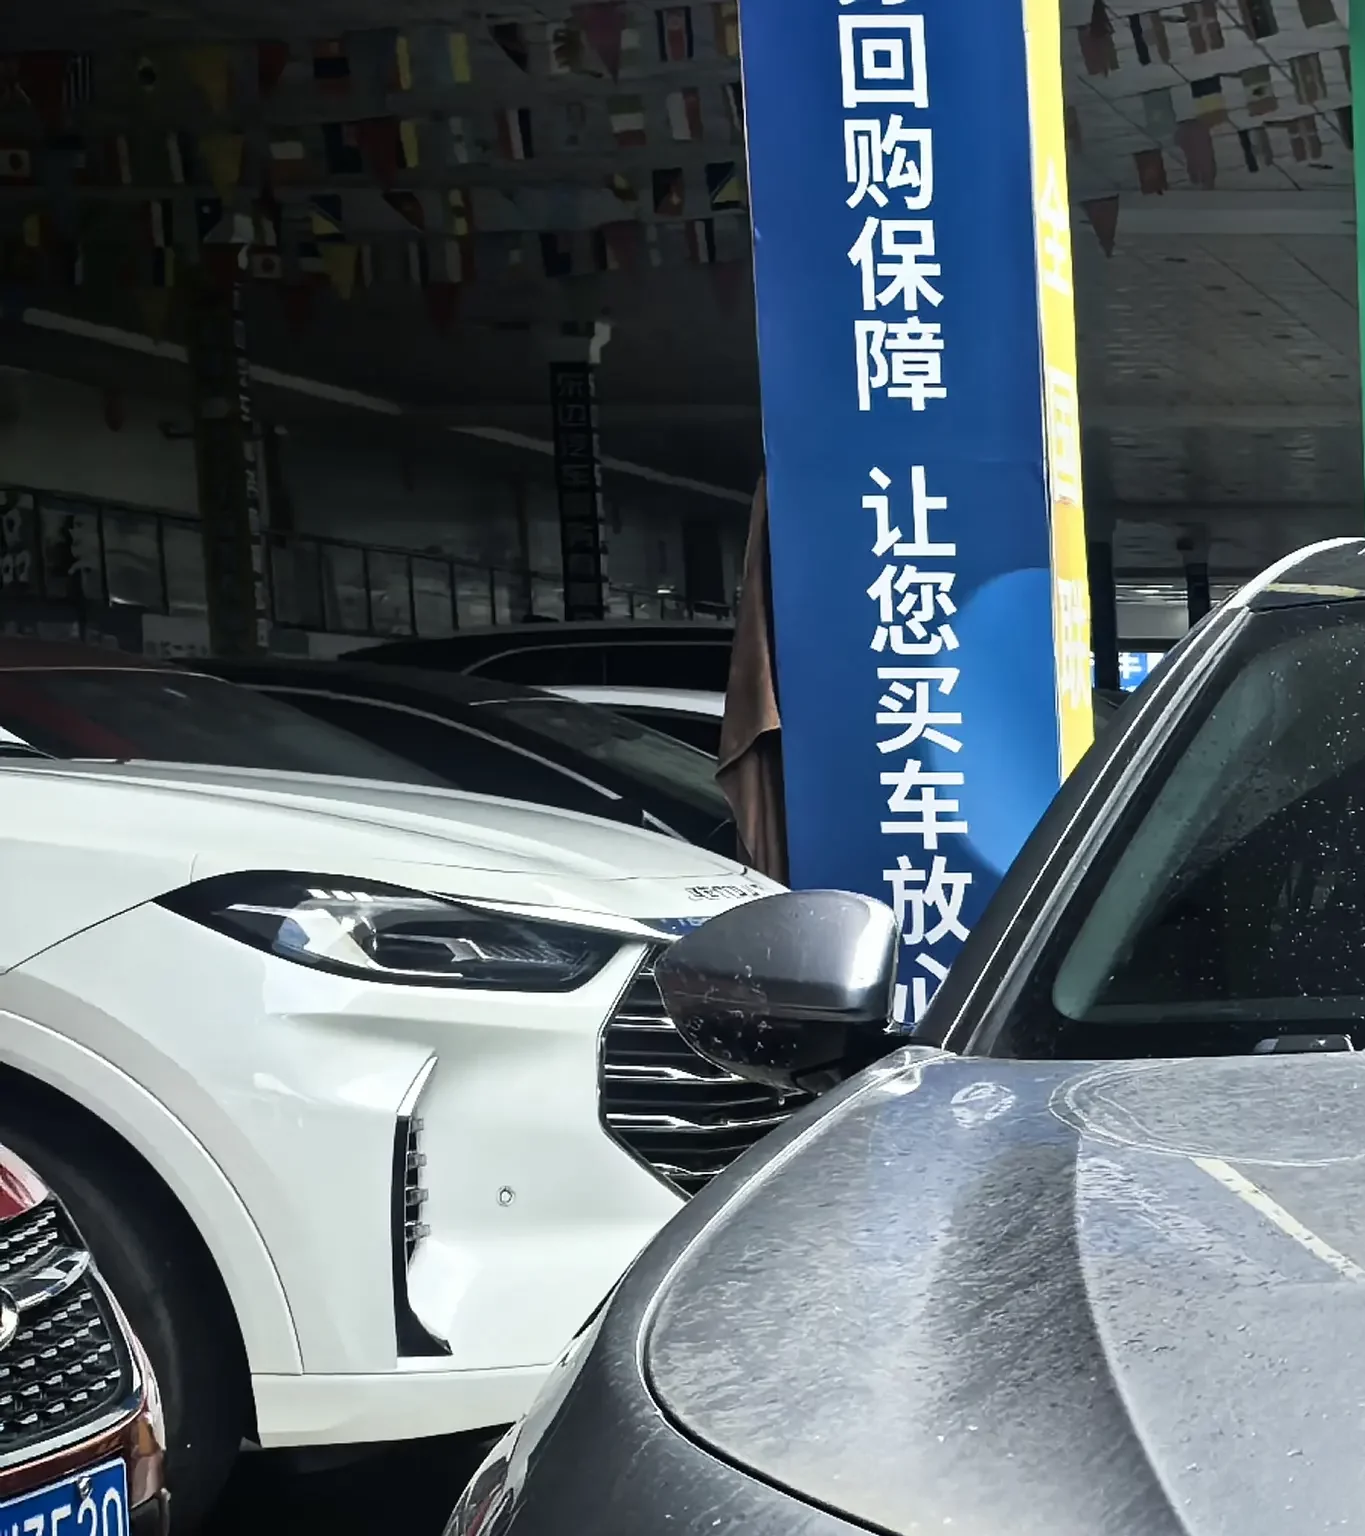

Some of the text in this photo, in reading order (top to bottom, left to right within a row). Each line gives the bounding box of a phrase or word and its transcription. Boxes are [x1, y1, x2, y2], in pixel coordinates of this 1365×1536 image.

[838, 0, 973, 1023] 回购保障 让您买车放心
